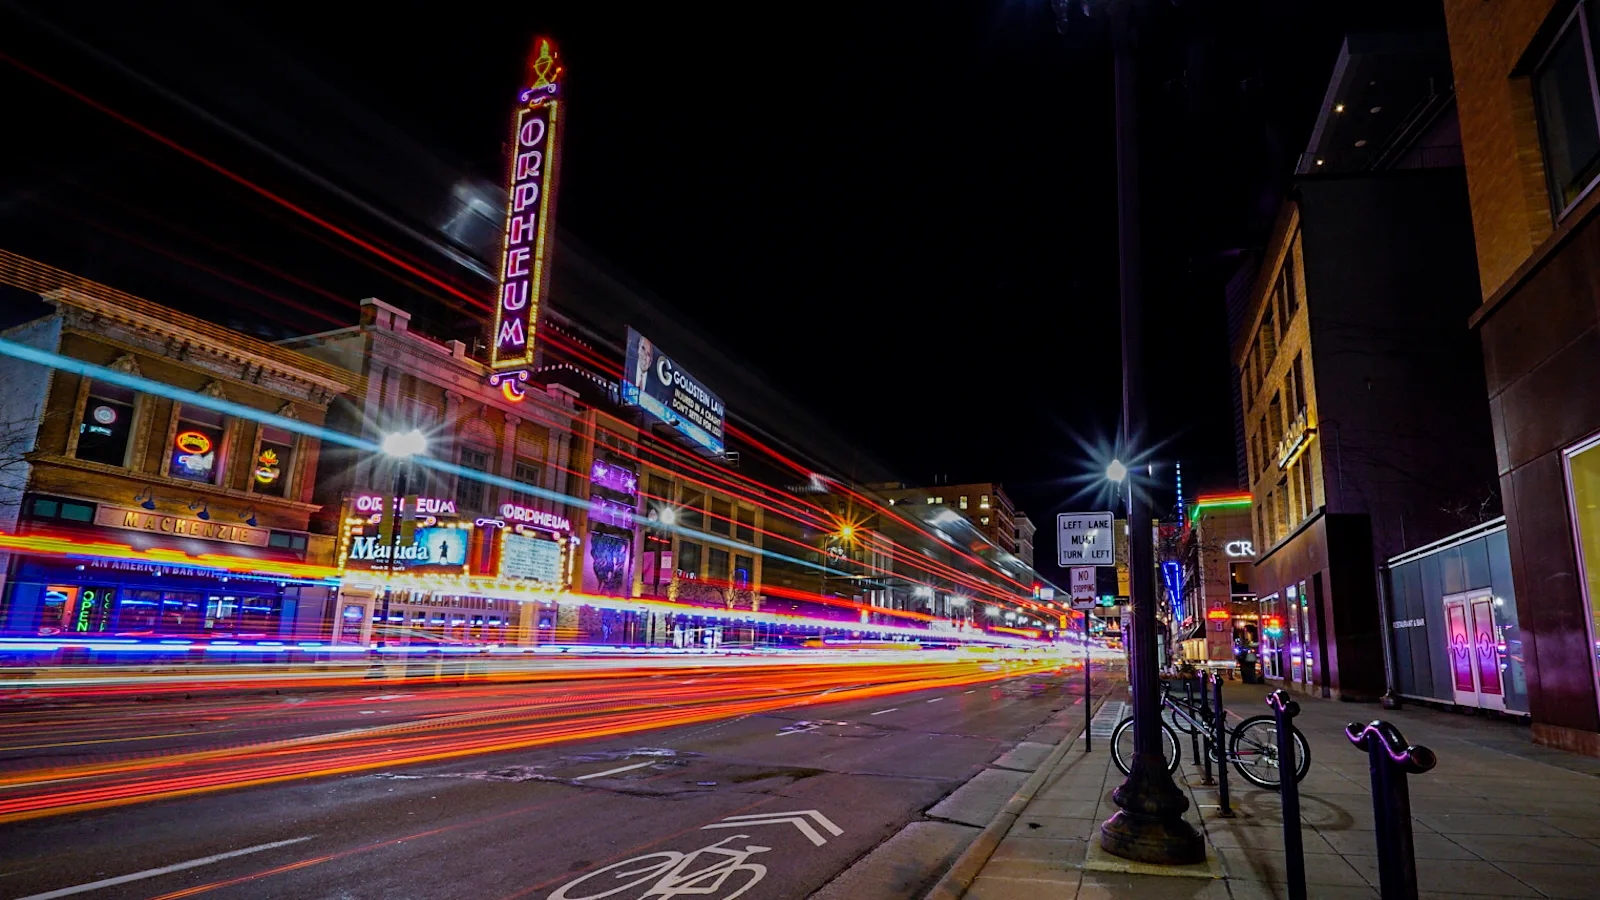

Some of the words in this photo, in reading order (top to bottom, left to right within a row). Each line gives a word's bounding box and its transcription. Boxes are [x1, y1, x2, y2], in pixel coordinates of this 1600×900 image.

[496, 118, 545, 348] ORPHEUM
[656, 355, 673, 387] G
[673, 371, 710, 408] GOLDSTEIN
[711, 398, 724, 417] LAW
[674, 387, 694, 408] INJURED
[695, 403, 701, 413] IN
[672, 398, 689, 415] DON'T
[357, 495, 456, 514] OREUM
[123, 511, 249, 542] MACKENZIE
[502, 503, 571, 532] ORPHEUM
[1063, 520, 1082, 530] LEFT
[1088, 519, 1110, 529] LANE
[1071, 535, 1097, 545] MUST
[1063, 550, 1083, 559] TURN
[1091, 550, 1110, 559] LEFT
[90, 559, 108, 568] AN
[111, 561, 169, 575] AMERICAN
[172, 567, 193, 576] BAR
[1078, 570, 1089, 581] NO
[1073, 584, 1095, 593] STOPPING
[76, 590, 95, 632] OPEN
